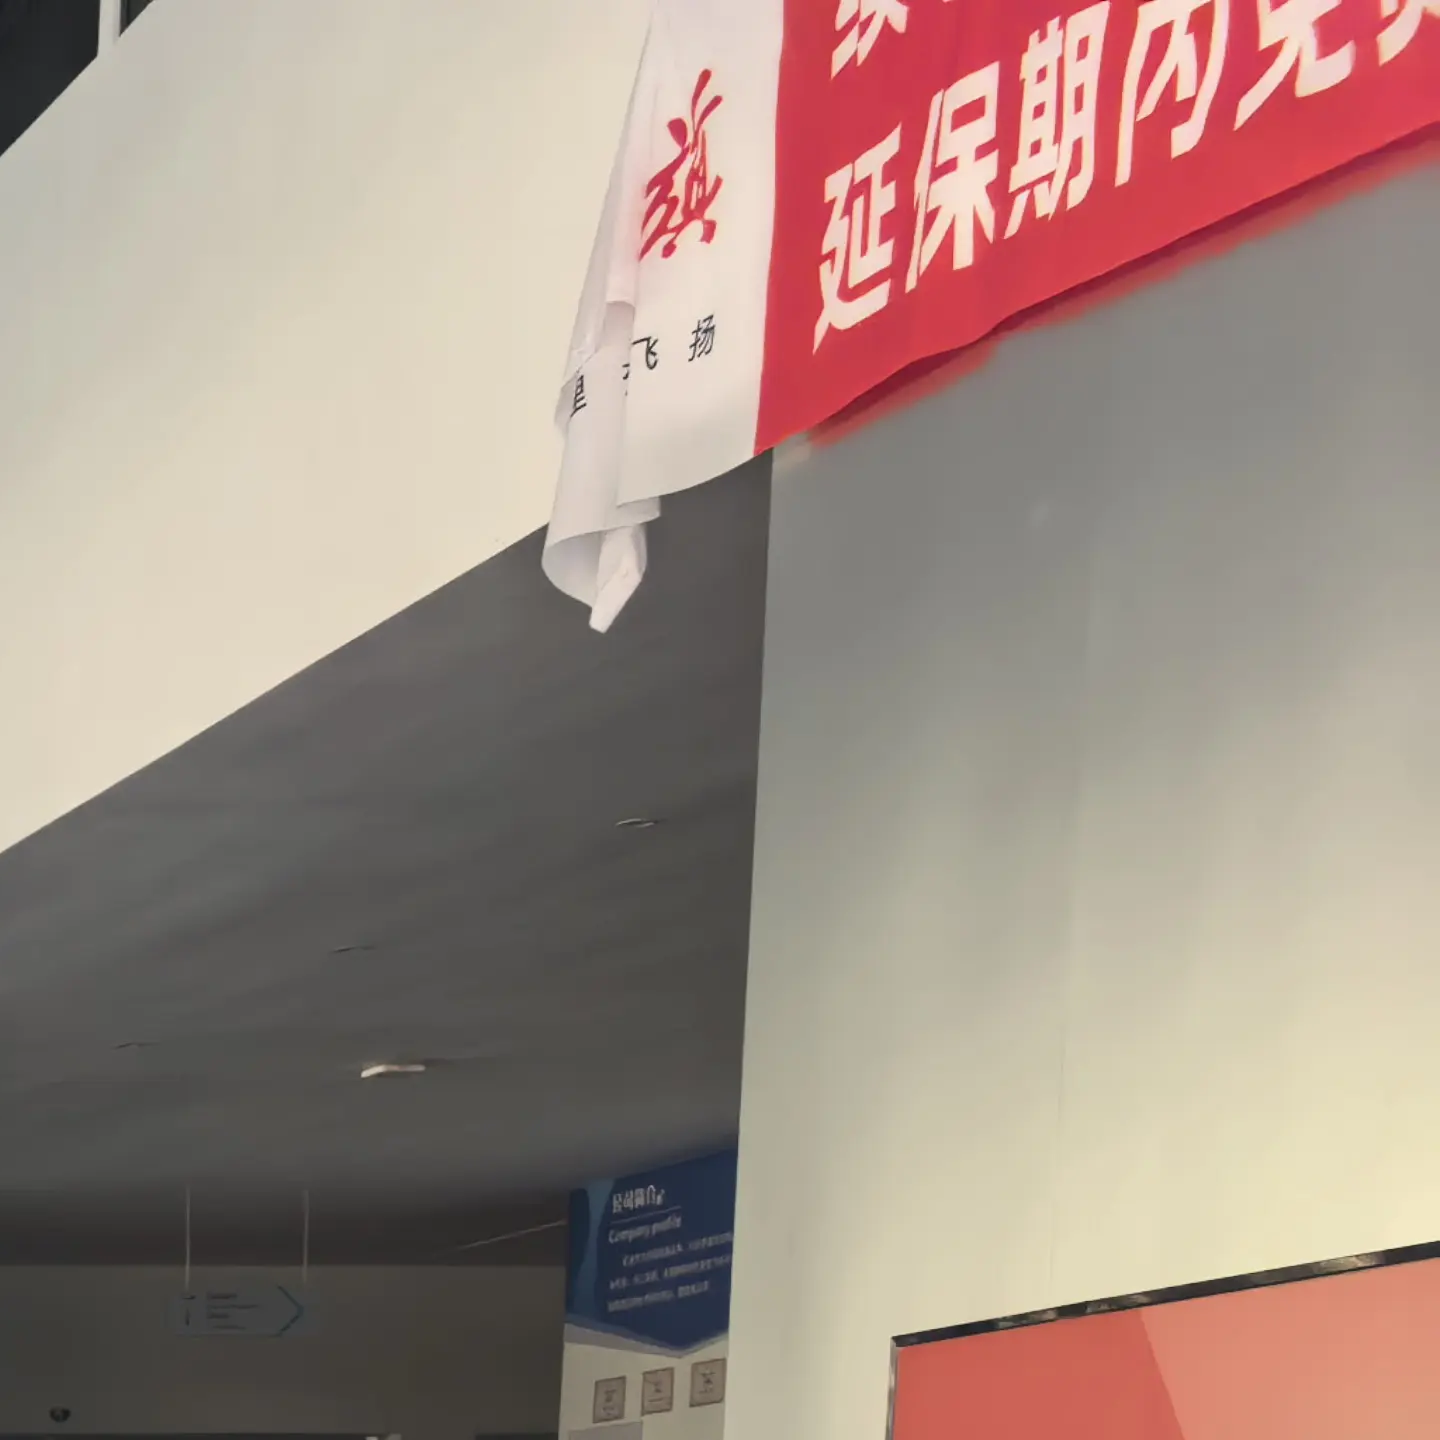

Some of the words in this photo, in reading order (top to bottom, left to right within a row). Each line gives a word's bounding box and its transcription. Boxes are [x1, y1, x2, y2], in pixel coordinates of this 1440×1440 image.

[812, 0, 1440, 354] 延保期内免
